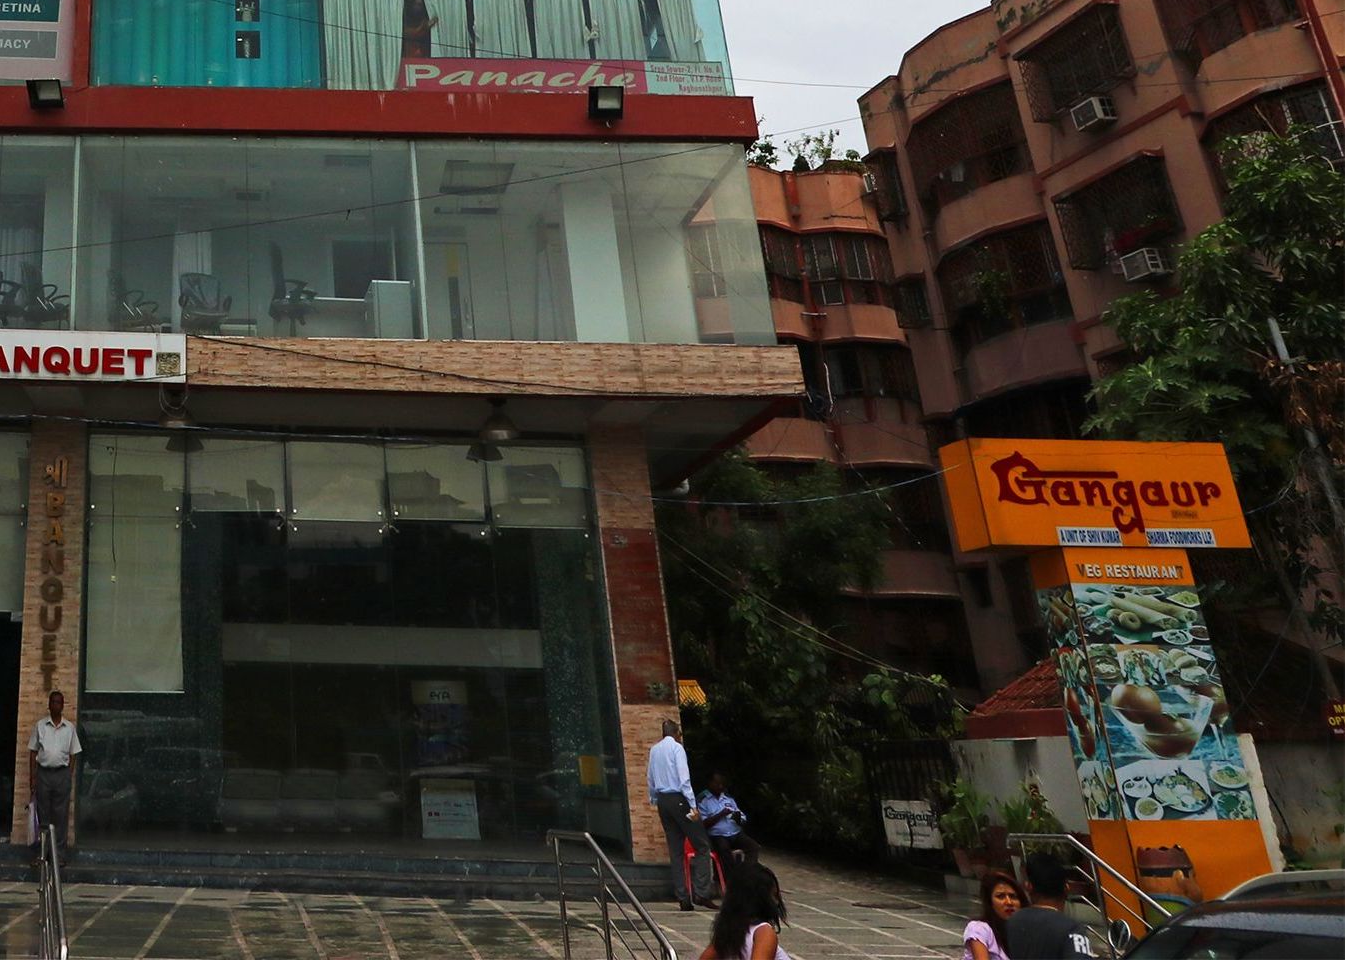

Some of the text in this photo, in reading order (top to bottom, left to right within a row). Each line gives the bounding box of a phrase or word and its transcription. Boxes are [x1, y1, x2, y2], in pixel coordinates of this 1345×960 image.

[405, 61, 637, 89] Panache
[990, 450, 1222, 535] Gangaur
[1066, 529, 1078, 543] UNIT
[1087, 529, 1102, 543] SHIV
[1101, 530, 1121, 543] KUMAR
